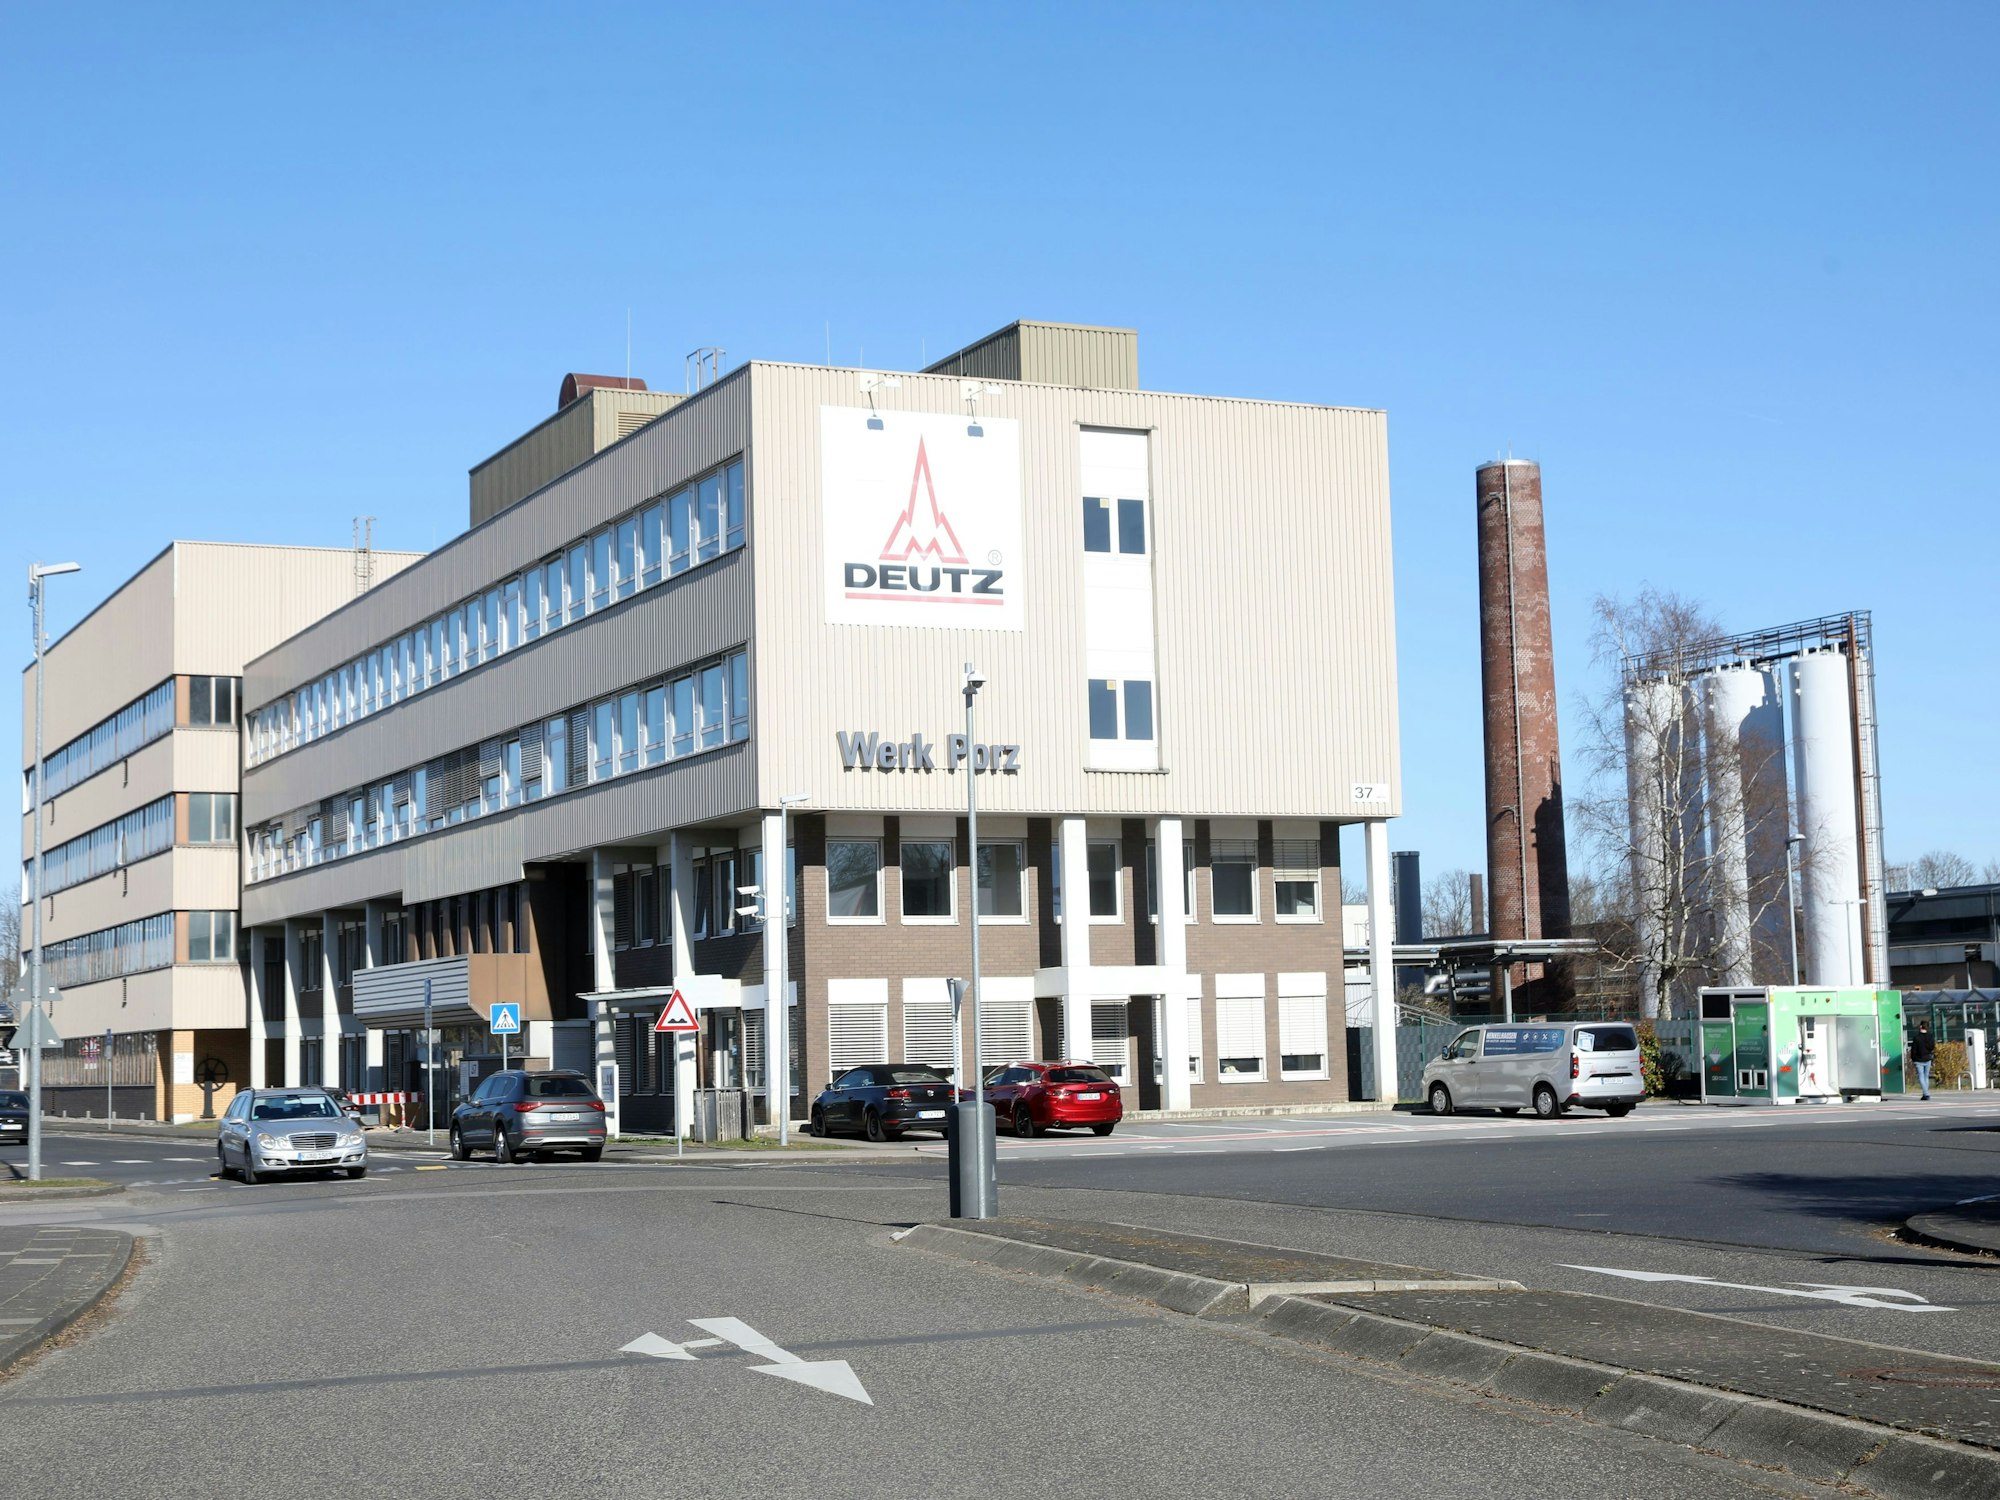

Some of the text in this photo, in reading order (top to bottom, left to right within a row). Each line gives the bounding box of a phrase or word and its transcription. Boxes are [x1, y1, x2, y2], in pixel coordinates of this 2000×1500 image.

[844, 562, 1004, 595] DEUTZ
[836, 730, 1021, 770] Werk Porz
[1354, 786, 1373, 799] 37
